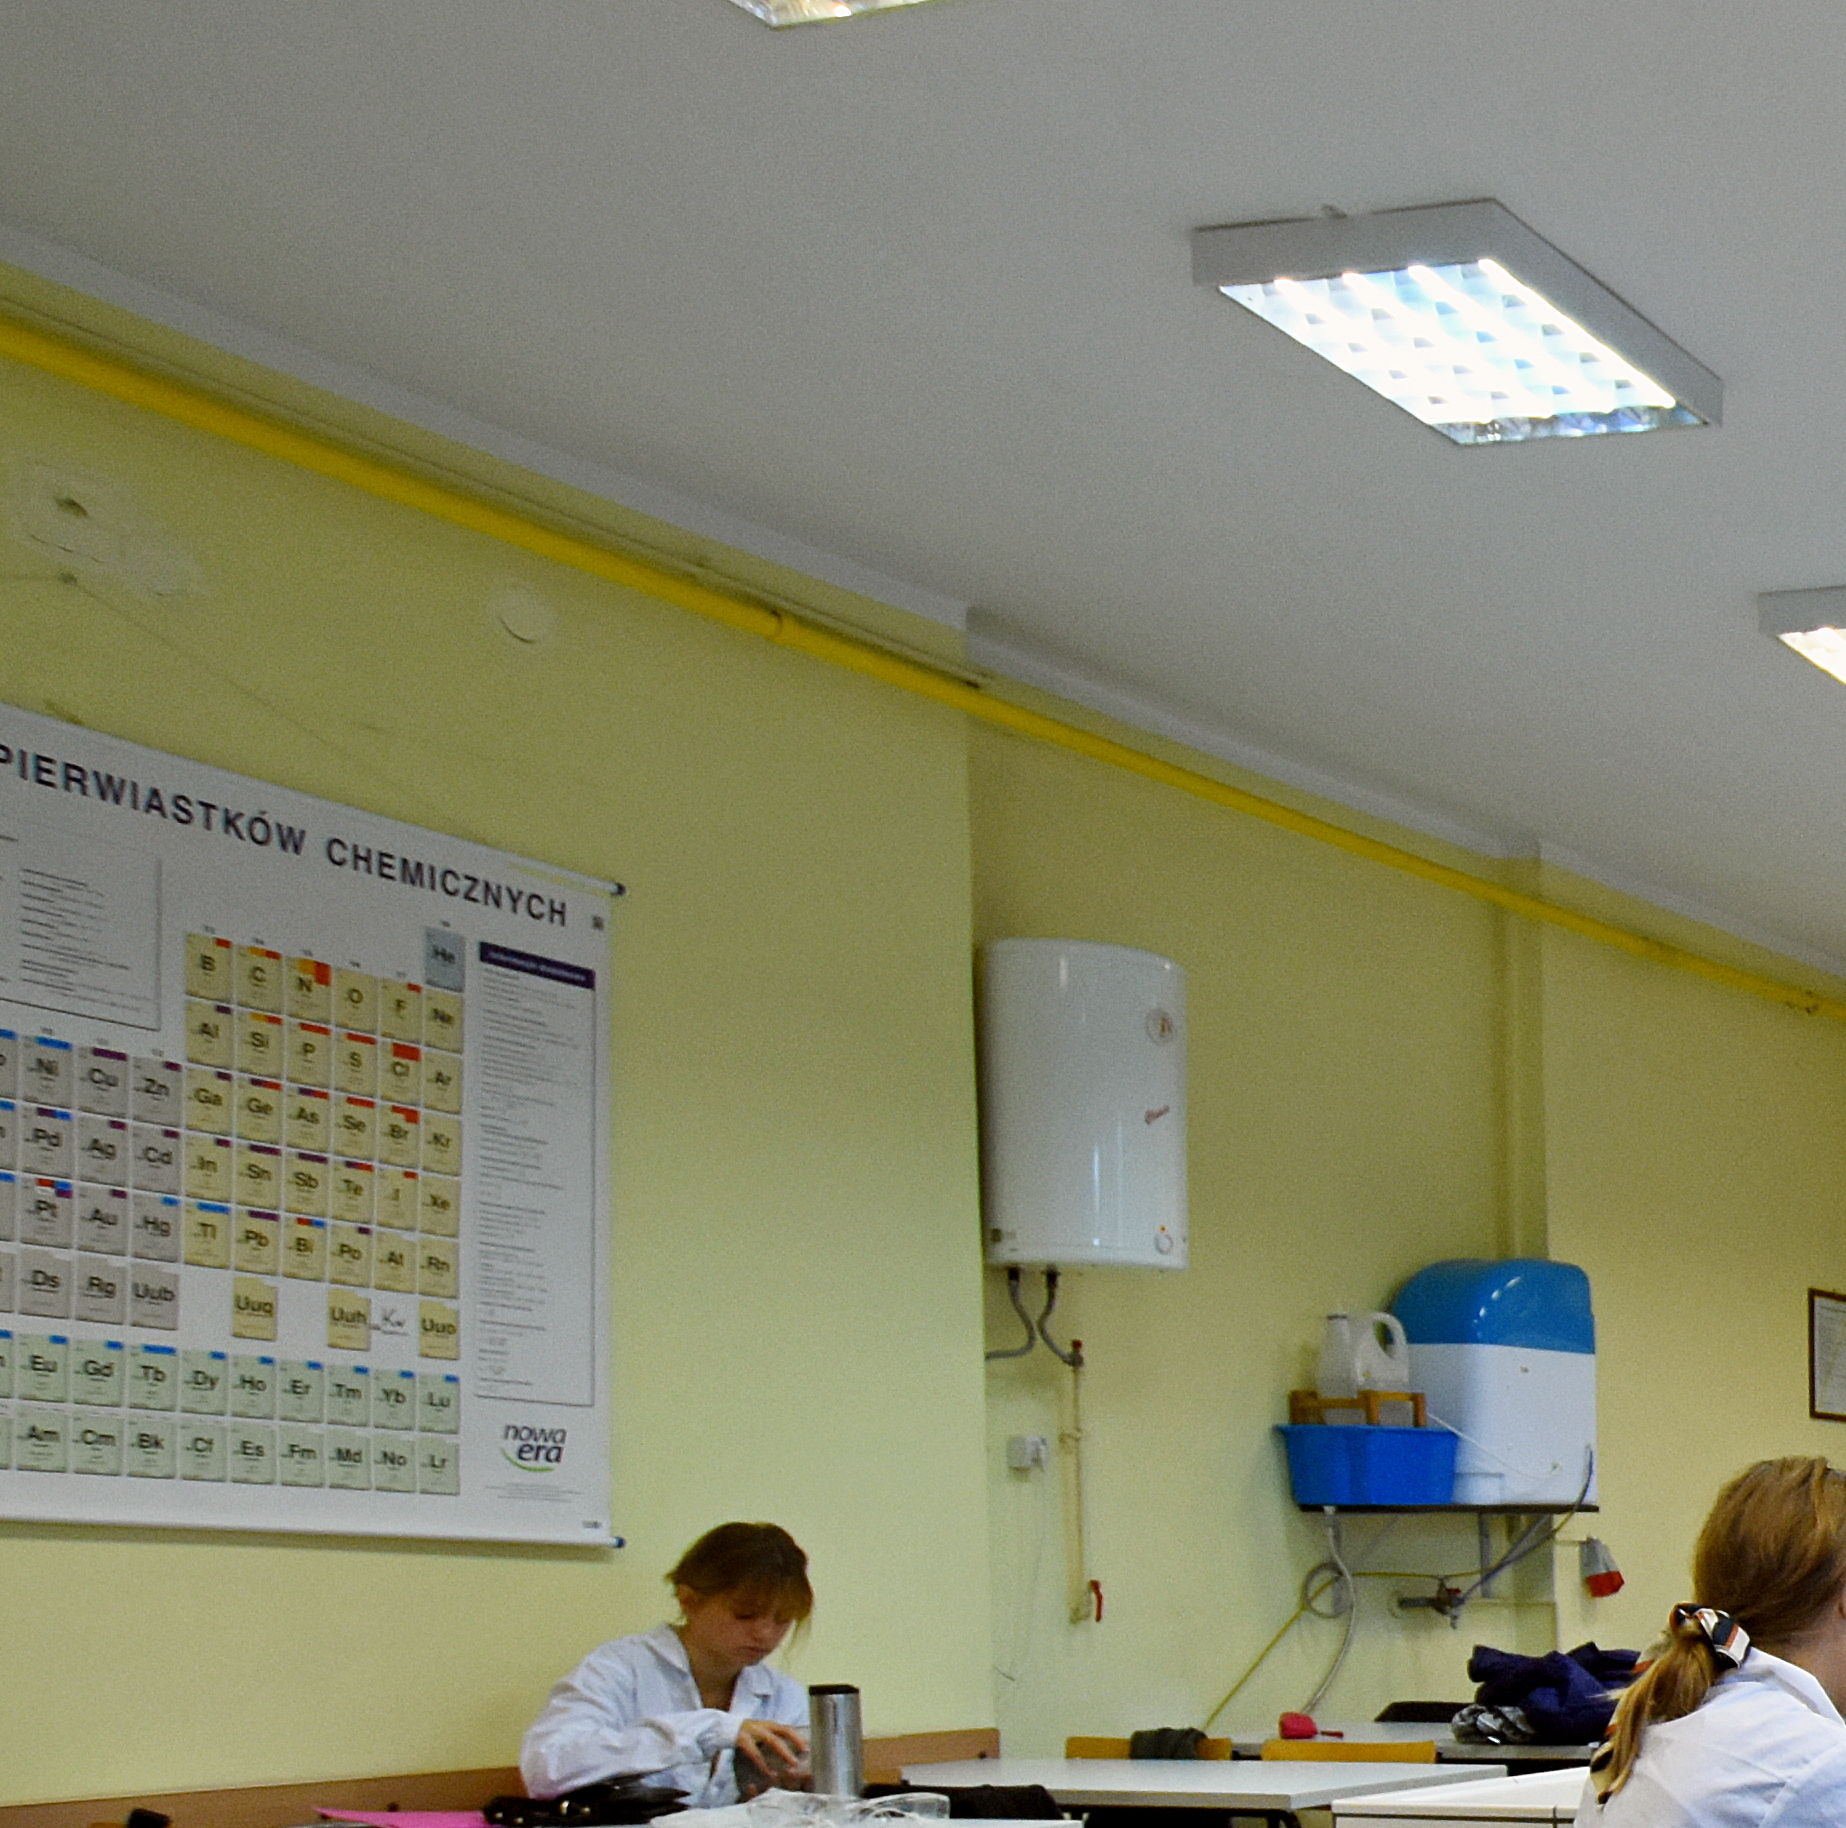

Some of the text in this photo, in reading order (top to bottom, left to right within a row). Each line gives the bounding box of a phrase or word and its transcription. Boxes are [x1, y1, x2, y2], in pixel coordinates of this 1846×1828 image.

[325, 837, 567, 927] CHEMICZNYCH
[200, 954, 215, 972] B
[251, 966, 266, 982] C
[298, 977, 312, 993] N
[348, 988, 363, 1004] O
[302, 1042, 316, 1056] P
[349, 1052, 362, 1068] S
[88, 1067, 118, 1087] Cu
[144, 1077, 170, 1096] Zn
[247, 1098, 273, 1115] Ge
[296, 1107, 320, 1124] As
[343, 1115, 366, 1133] Se
[33, 1128, 61, 1147] Pd
[90, 1138, 116, 1160] Ag
[144, 1147, 172, 1165] Cd
[247, 1164, 272, 1181] Sn
[294, 1172, 318, 1189] Sb
[343, 1180, 363, 1195] Te
[35, 1200, 57, 1218] Pt
[90, 1208, 118, 1226] Au
[143, 1216, 171, 1237] Hg
[244, 1230, 269, 1247] Pb
[339, 1244, 362, 1260] Po
[428, 1257, 450, 1272] Rn
[32, 1270, 60, 1288] Ds
[88, 1276, 116, 1299] Rg
[132, 1282, 175, 1302] Uub
[330, 1307, 368, 1324] Uuh
[421, 1318, 457, 1335] Uuo
[30, 1355, 57, 1372] Eu
[83, 1360, 114, 1377] Gd
[141, 1365, 166, 1382] Tb
[192, 1370, 218, 1390] Dy
[240, 1375, 267, 1392] Ho
[291, 1379, 310, 1396] Er
[335, 1384, 361, 1399] Tm
[383, 1389, 406, 1405] Yb
[429, 1393, 450, 1408] Lu
[27, 1426, 60, 1442] Am
[81, 1429, 116, 1446] Cm
[137, 1433, 164, 1449] Bk
[503, 1424, 567, 1445] nowa
[240, 1440, 264, 1457] Es
[289, 1444, 316, 1460] Fm
[337, 1448, 362, 1463] Md
[516, 1443, 564, 1464] era
[382, 1451, 407, 1466] No
[430, 1454, 447, 1469] Lr
